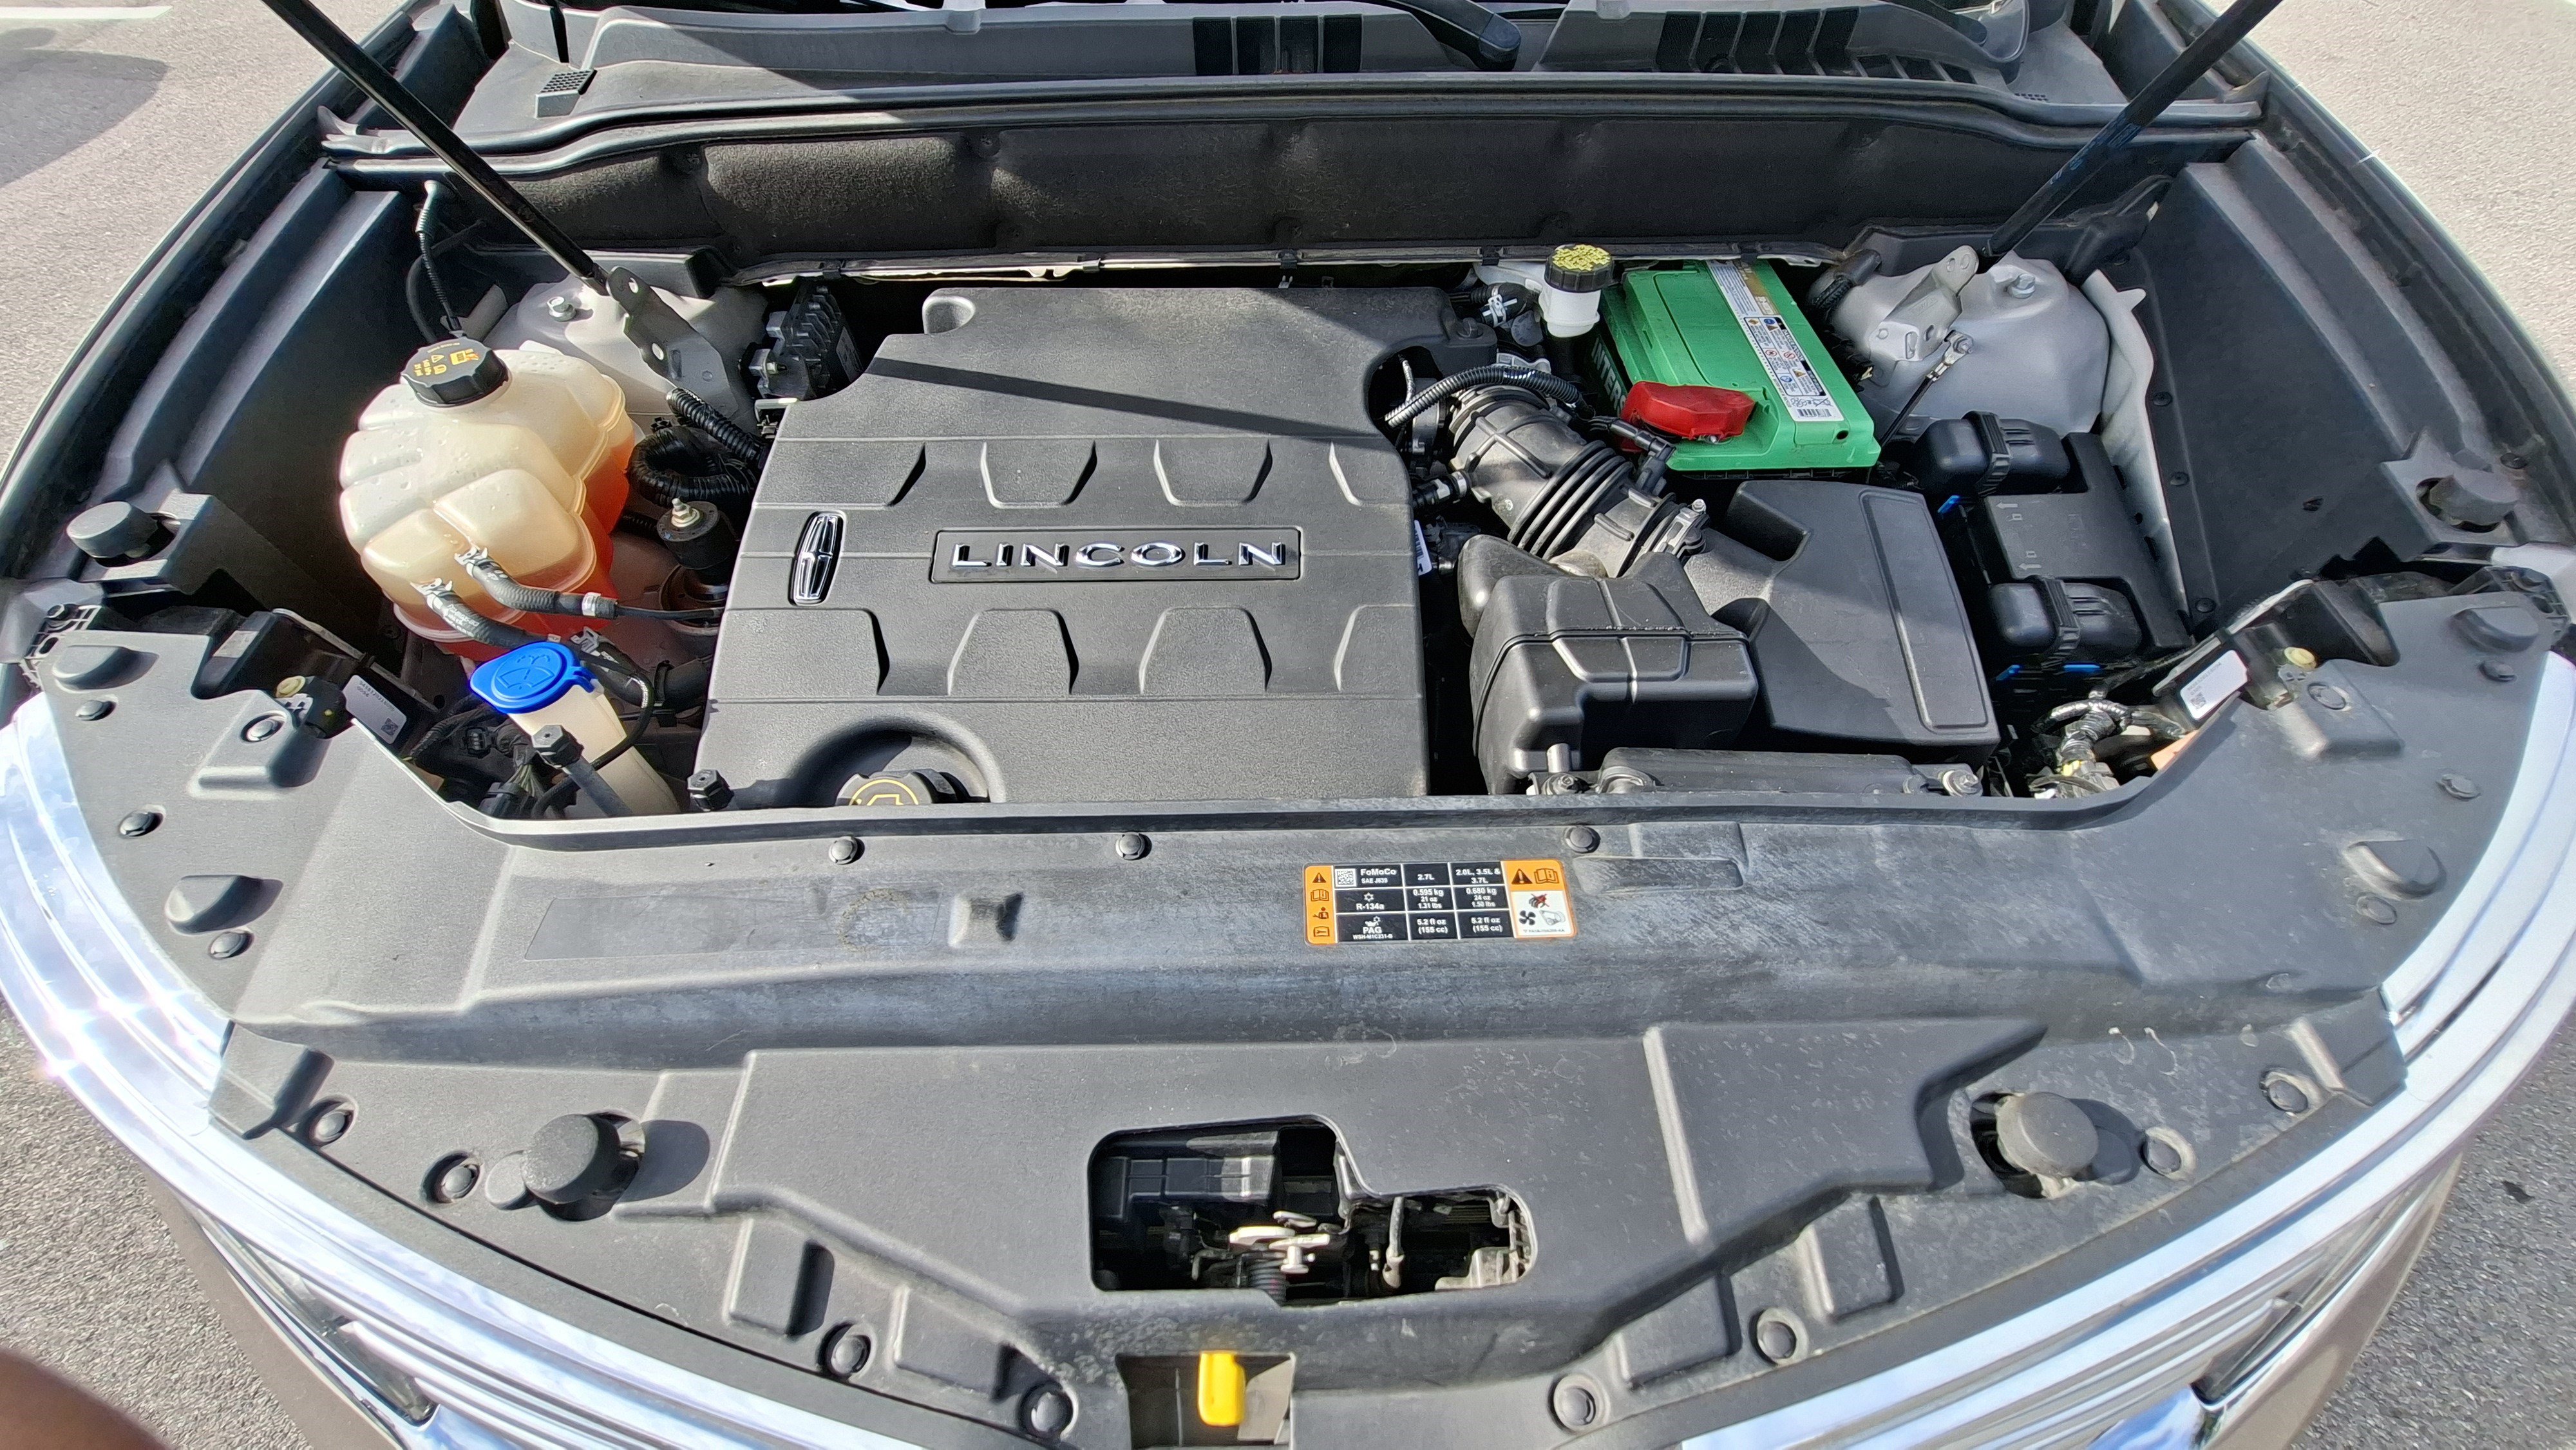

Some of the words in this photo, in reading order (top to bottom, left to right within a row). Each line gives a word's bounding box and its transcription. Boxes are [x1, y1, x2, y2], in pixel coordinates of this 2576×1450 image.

[952, 541, 1287, 569] LINCOLN
[1434, 889, 1444, 897] kg
[1486, 887, 1497, 896] kg
[1418, 927, 1435, 935] (155
[1472, 925, 1489, 933] (155
